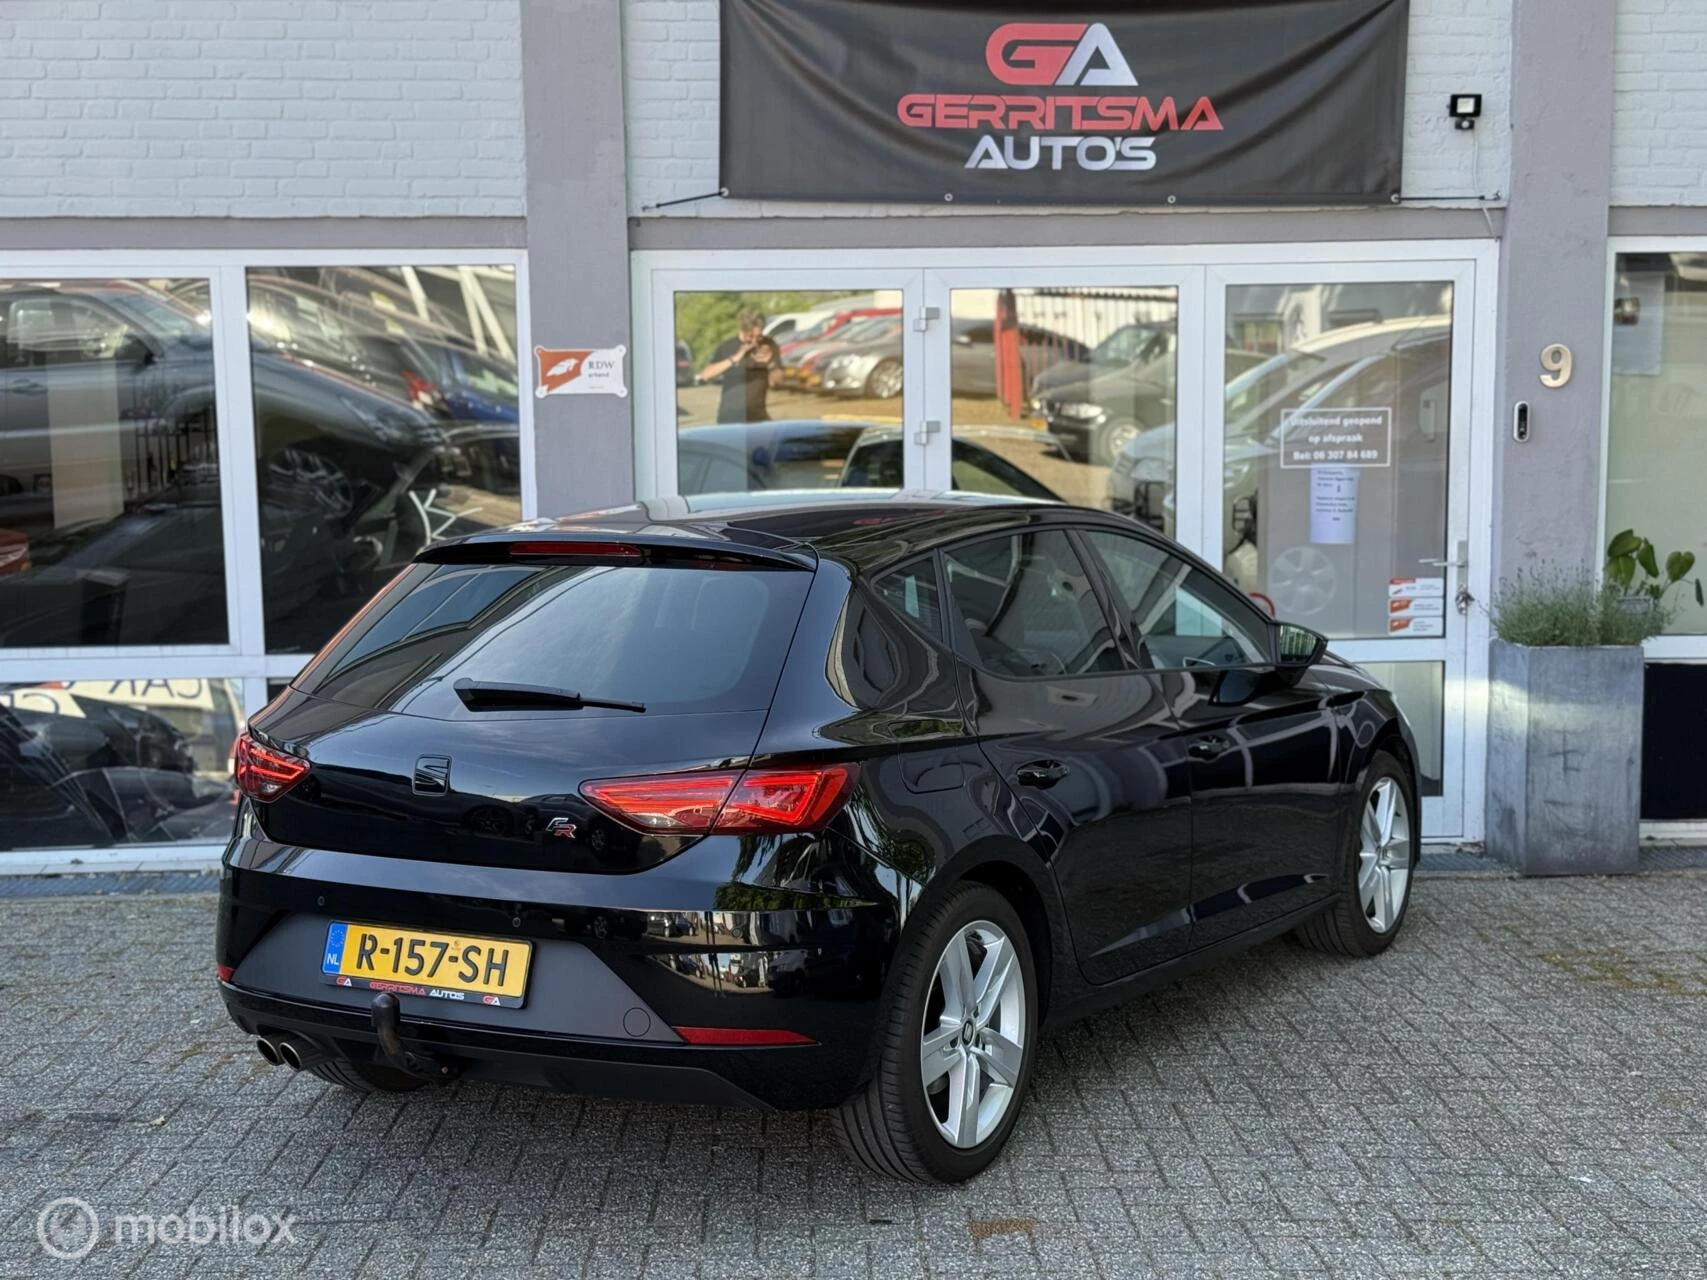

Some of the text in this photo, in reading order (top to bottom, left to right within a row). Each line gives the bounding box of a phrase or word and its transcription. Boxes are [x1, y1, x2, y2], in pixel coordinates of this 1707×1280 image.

[985, 22, 1139, 86] GA
[897, 94, 1224, 130] GERRITSMA
[964, 134, 1157, 170] AUTO'S
[588, 360, 615, 369] RDW
[1540, 343, 1573, 388] 9
[1308, 433, 1363, 445] op afspraak
[1342, 416, 1382, 427] geopend
[326, 933, 510, 987] NL R-157-SH
